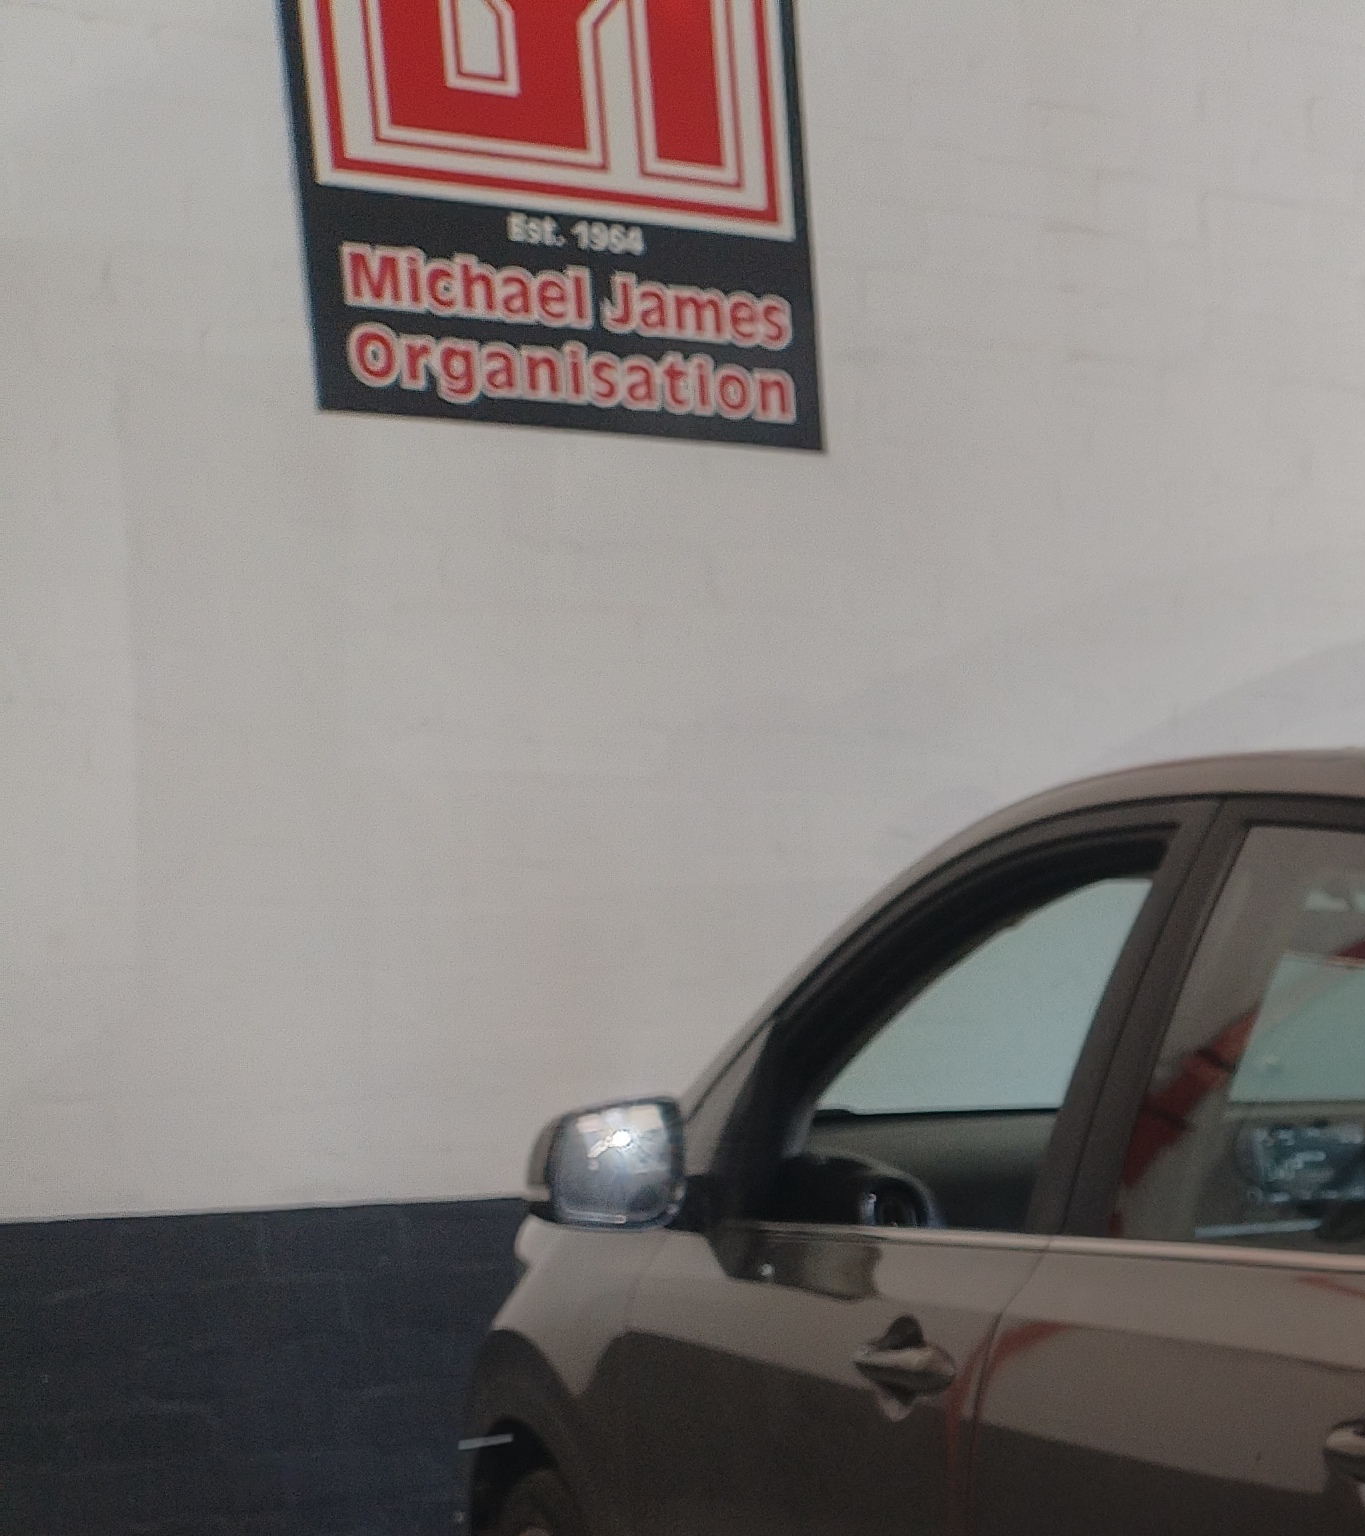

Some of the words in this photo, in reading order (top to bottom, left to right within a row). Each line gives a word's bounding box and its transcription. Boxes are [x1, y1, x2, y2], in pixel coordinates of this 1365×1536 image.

[507, 211, 564, 247] Est.
[571, 219, 644, 256] 1964
[341, 242, 592, 328] Michael
[602, 272, 793, 350] James
[348, 322, 796, 424] Organisation
